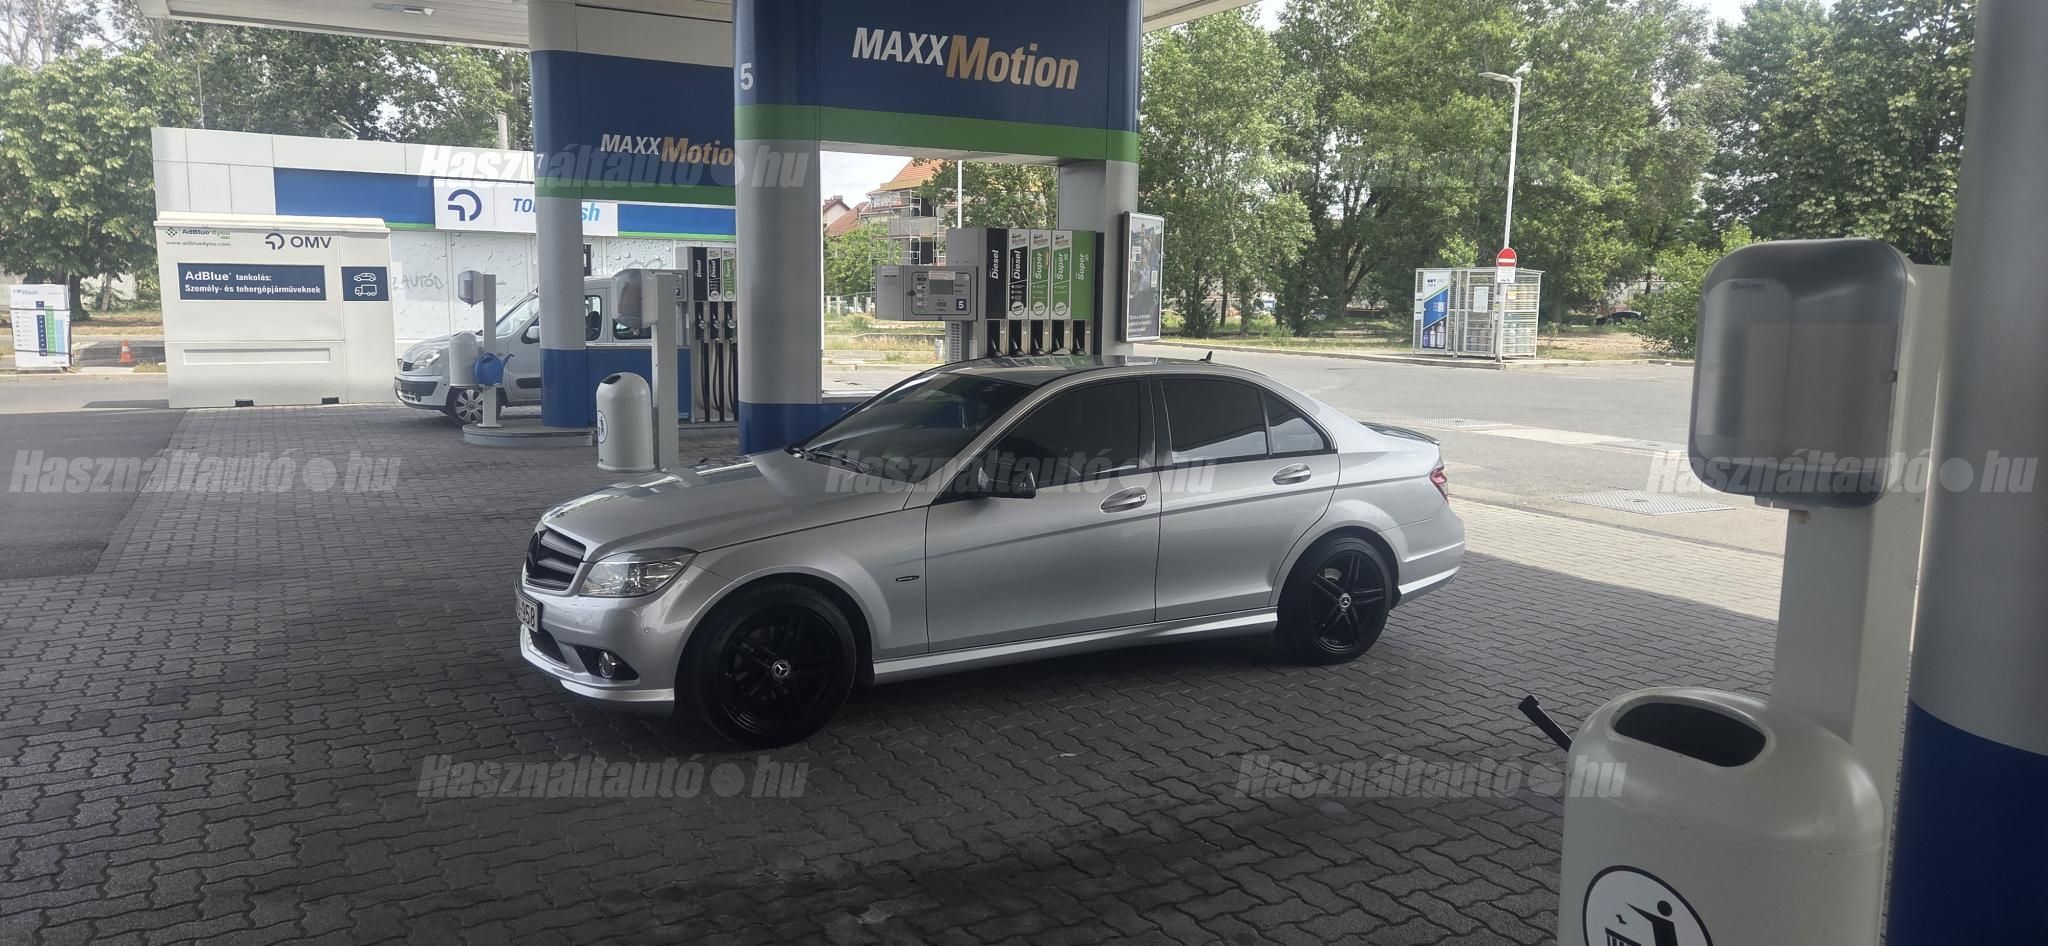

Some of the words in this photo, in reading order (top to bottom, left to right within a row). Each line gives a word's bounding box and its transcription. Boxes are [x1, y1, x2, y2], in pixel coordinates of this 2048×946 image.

[740, 62, 754, 90] 5
[600, 133, 735, 166] MAXXMotio
[536, 153, 545, 169] 7
[290, 236, 332, 249] OMV
[958, 300, 964, 309] 5
